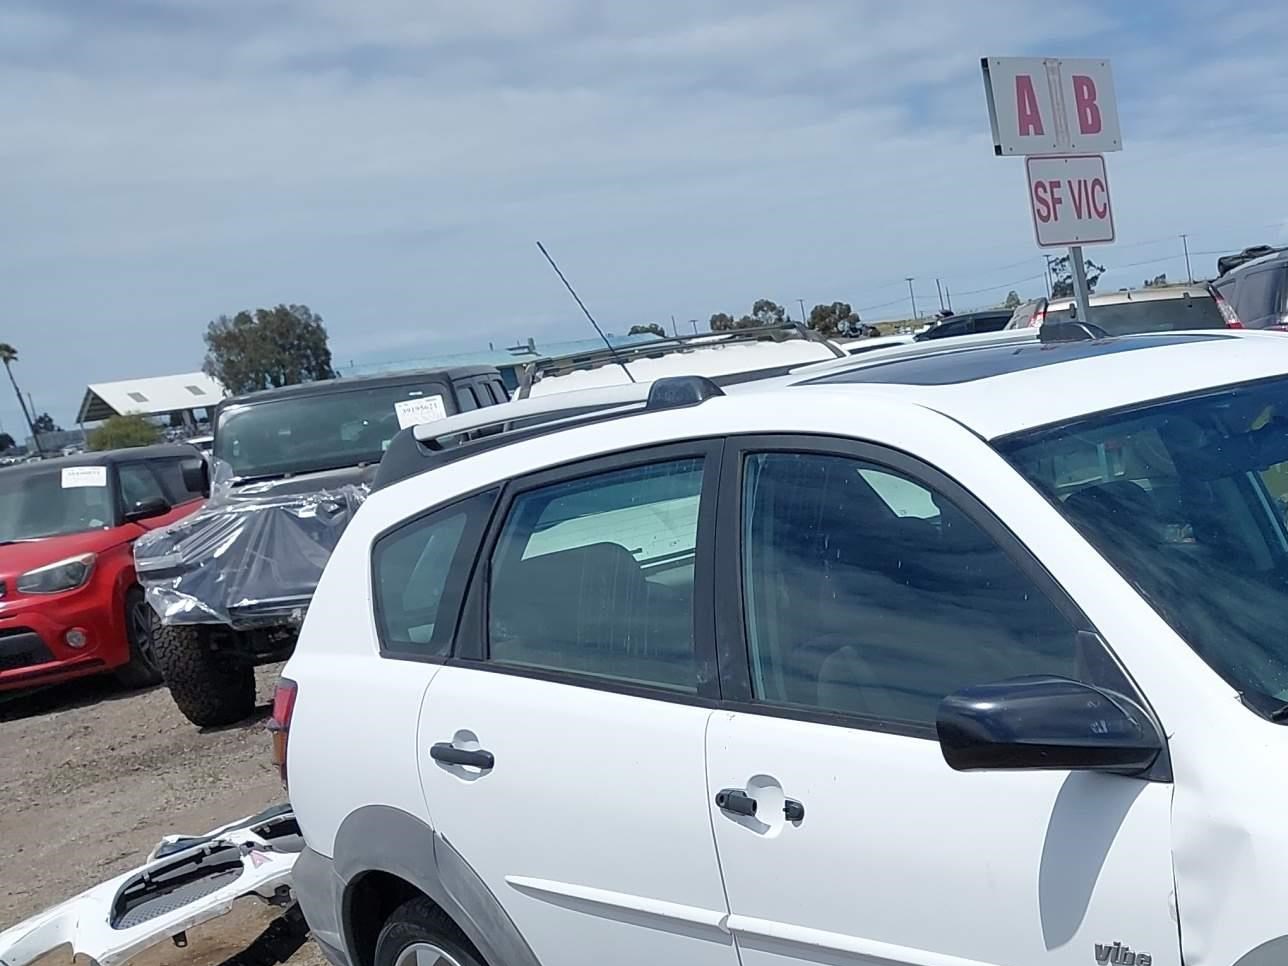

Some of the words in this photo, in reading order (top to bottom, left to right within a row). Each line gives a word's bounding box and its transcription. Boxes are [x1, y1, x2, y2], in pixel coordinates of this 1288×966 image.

[1015, 75, 1044, 136] A
[1072, 75, 1102, 135] B
[1033, 180, 1063, 223] SF
[1068, 178, 1108, 220] VIC
